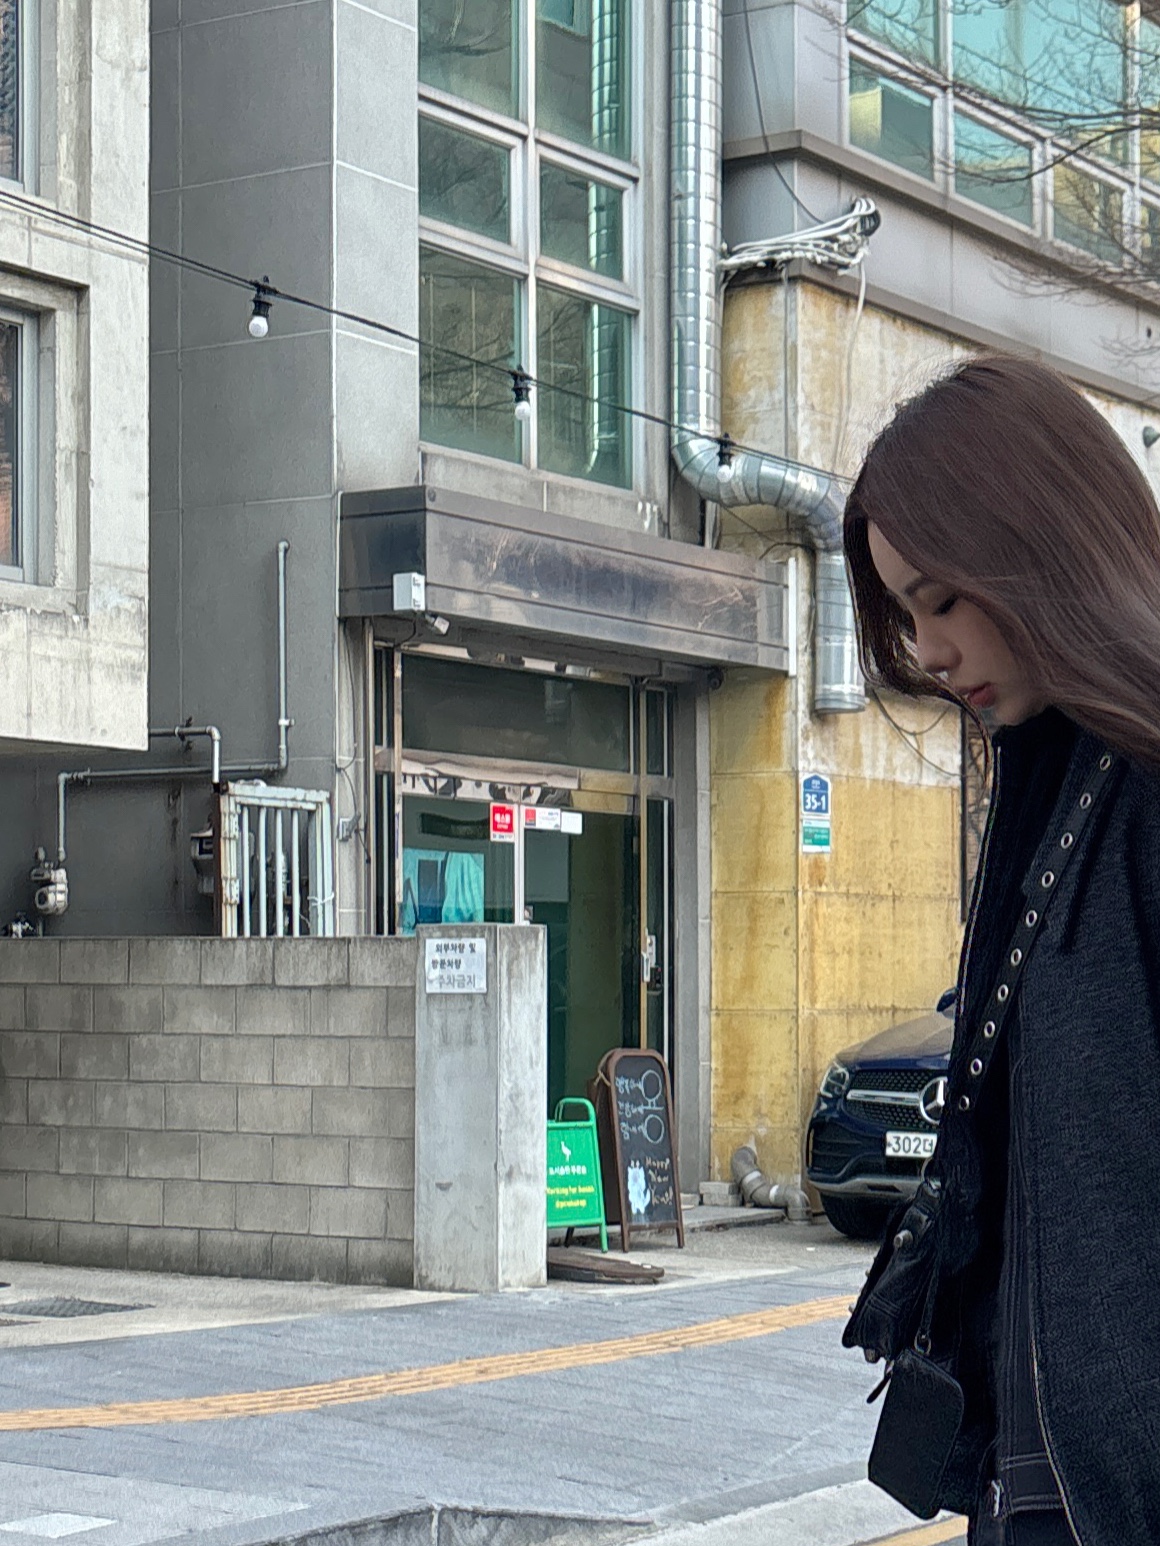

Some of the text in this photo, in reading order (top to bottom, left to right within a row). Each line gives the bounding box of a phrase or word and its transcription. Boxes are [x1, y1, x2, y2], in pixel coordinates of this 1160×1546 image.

[804, 792, 828, 811] 35-1
[435, 943, 465, 954] 외부차량
[439, 973, 476, 989] 주차금지
[645, 1155, 670, 1170] Happy
[648, 1169, 669, 1183] New
